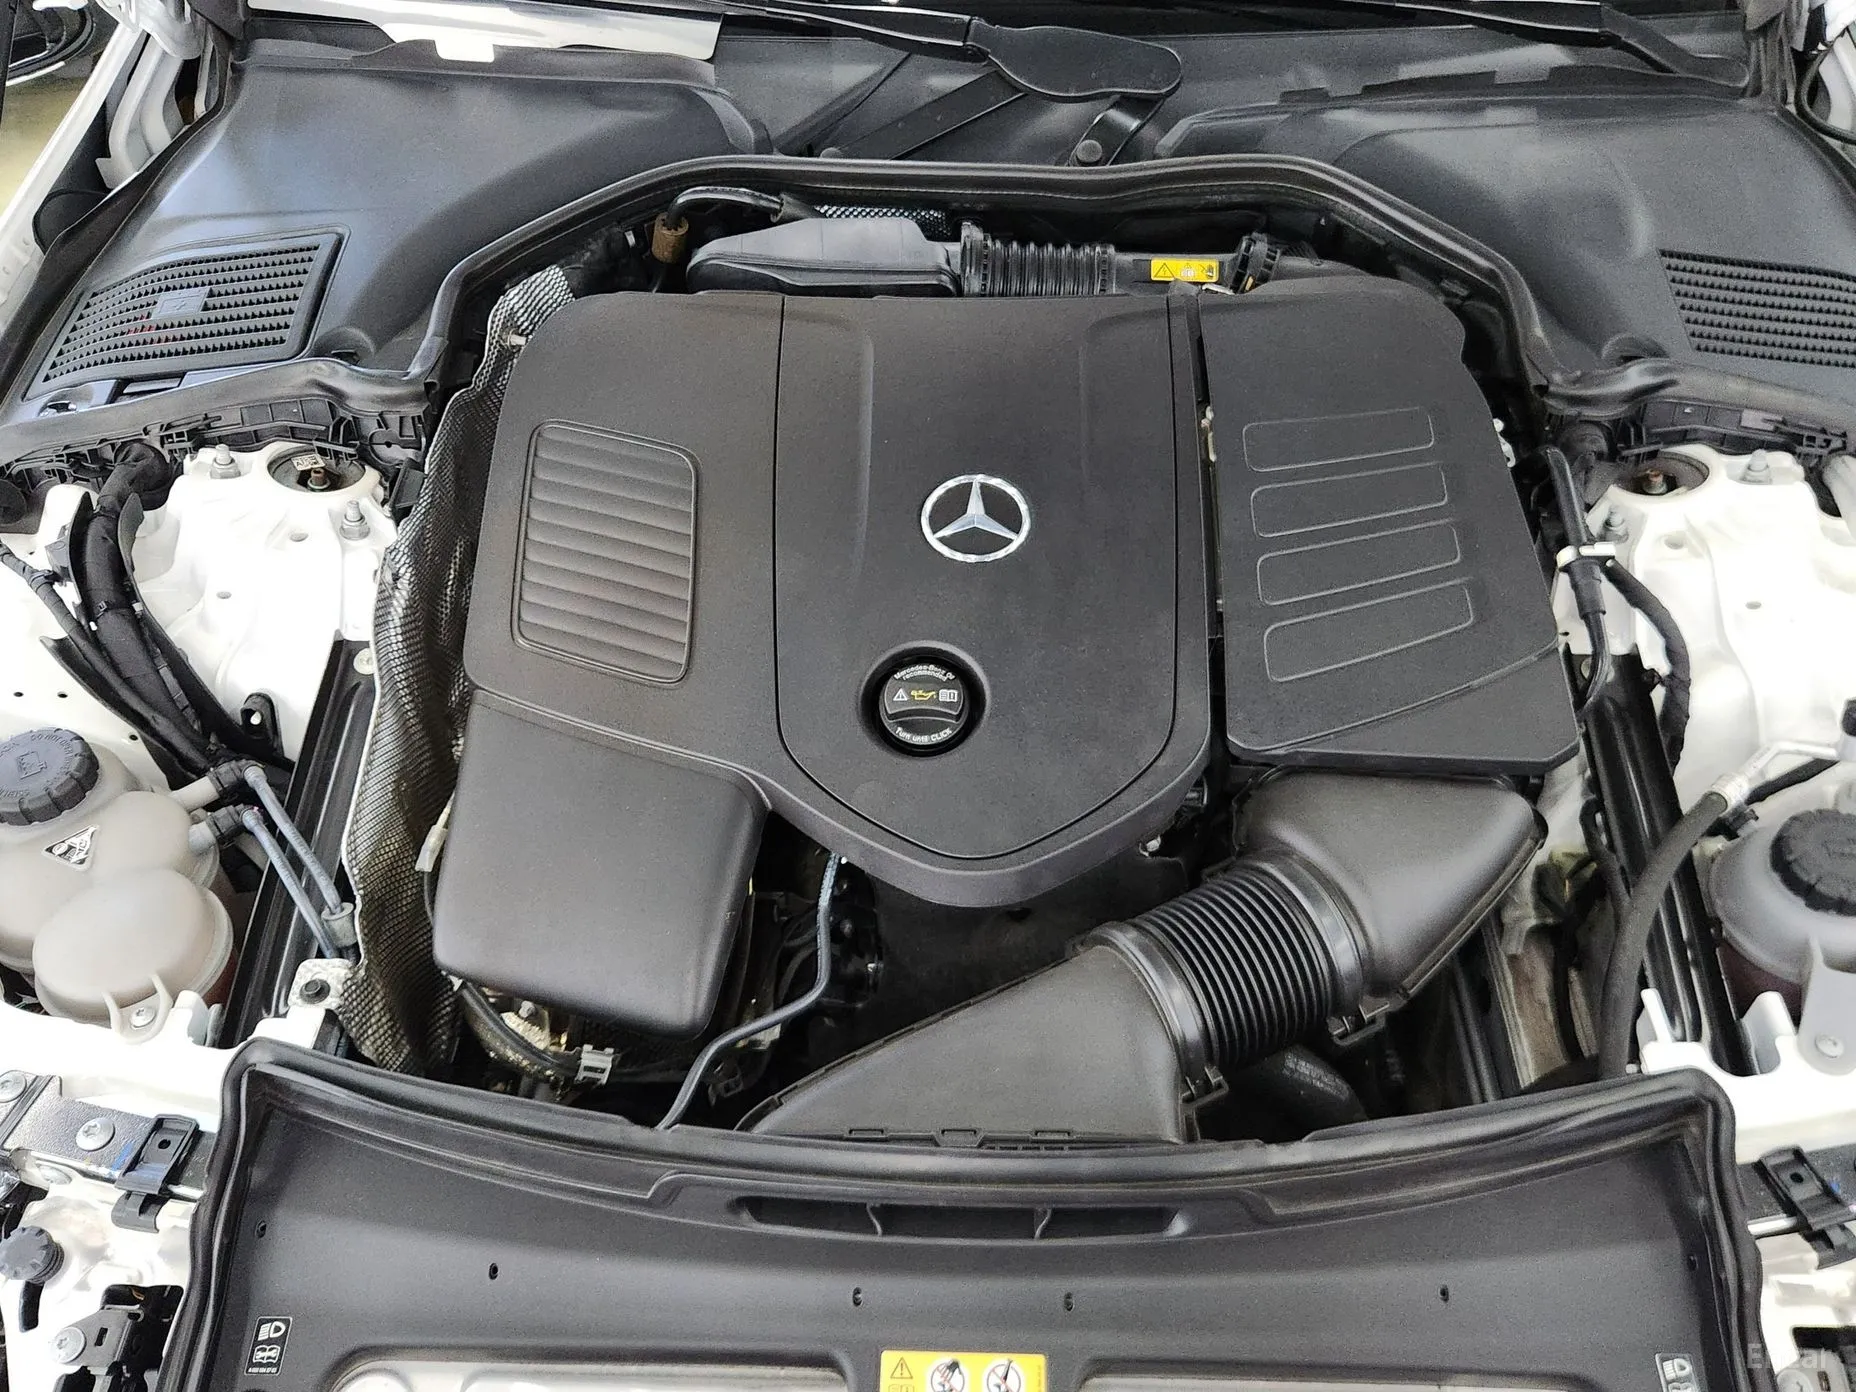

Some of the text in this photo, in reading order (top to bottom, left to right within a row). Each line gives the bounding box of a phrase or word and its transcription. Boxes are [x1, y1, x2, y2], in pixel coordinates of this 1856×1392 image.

[894, 664, 946, 680] Mercedes-Benz
[902, 670, 948, 682] recommended
[895, 727, 912, 740] Turn
[930, 727, 953, 741] CLICK
